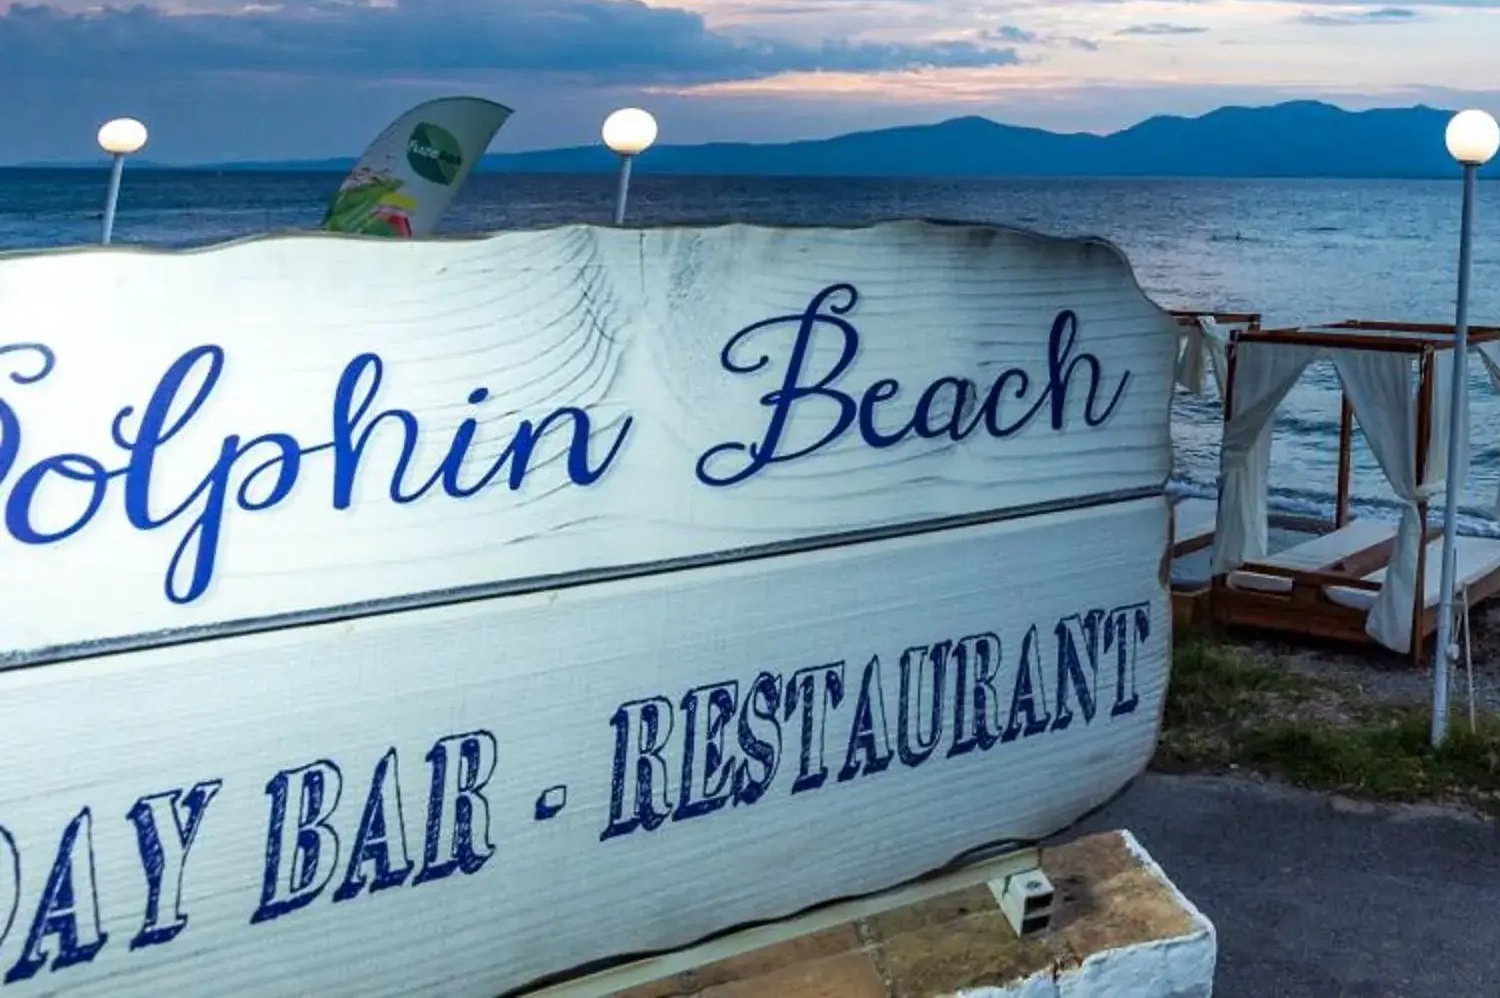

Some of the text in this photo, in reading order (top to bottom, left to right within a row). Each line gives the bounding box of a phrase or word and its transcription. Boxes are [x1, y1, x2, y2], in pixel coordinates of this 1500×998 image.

[0, 283, 1131, 604] olphin Beach
[0, 778, 223, 984] AY
[250, 729, 501, 925] BAR
[600, 602, 1151, 841] RESTAURANT
